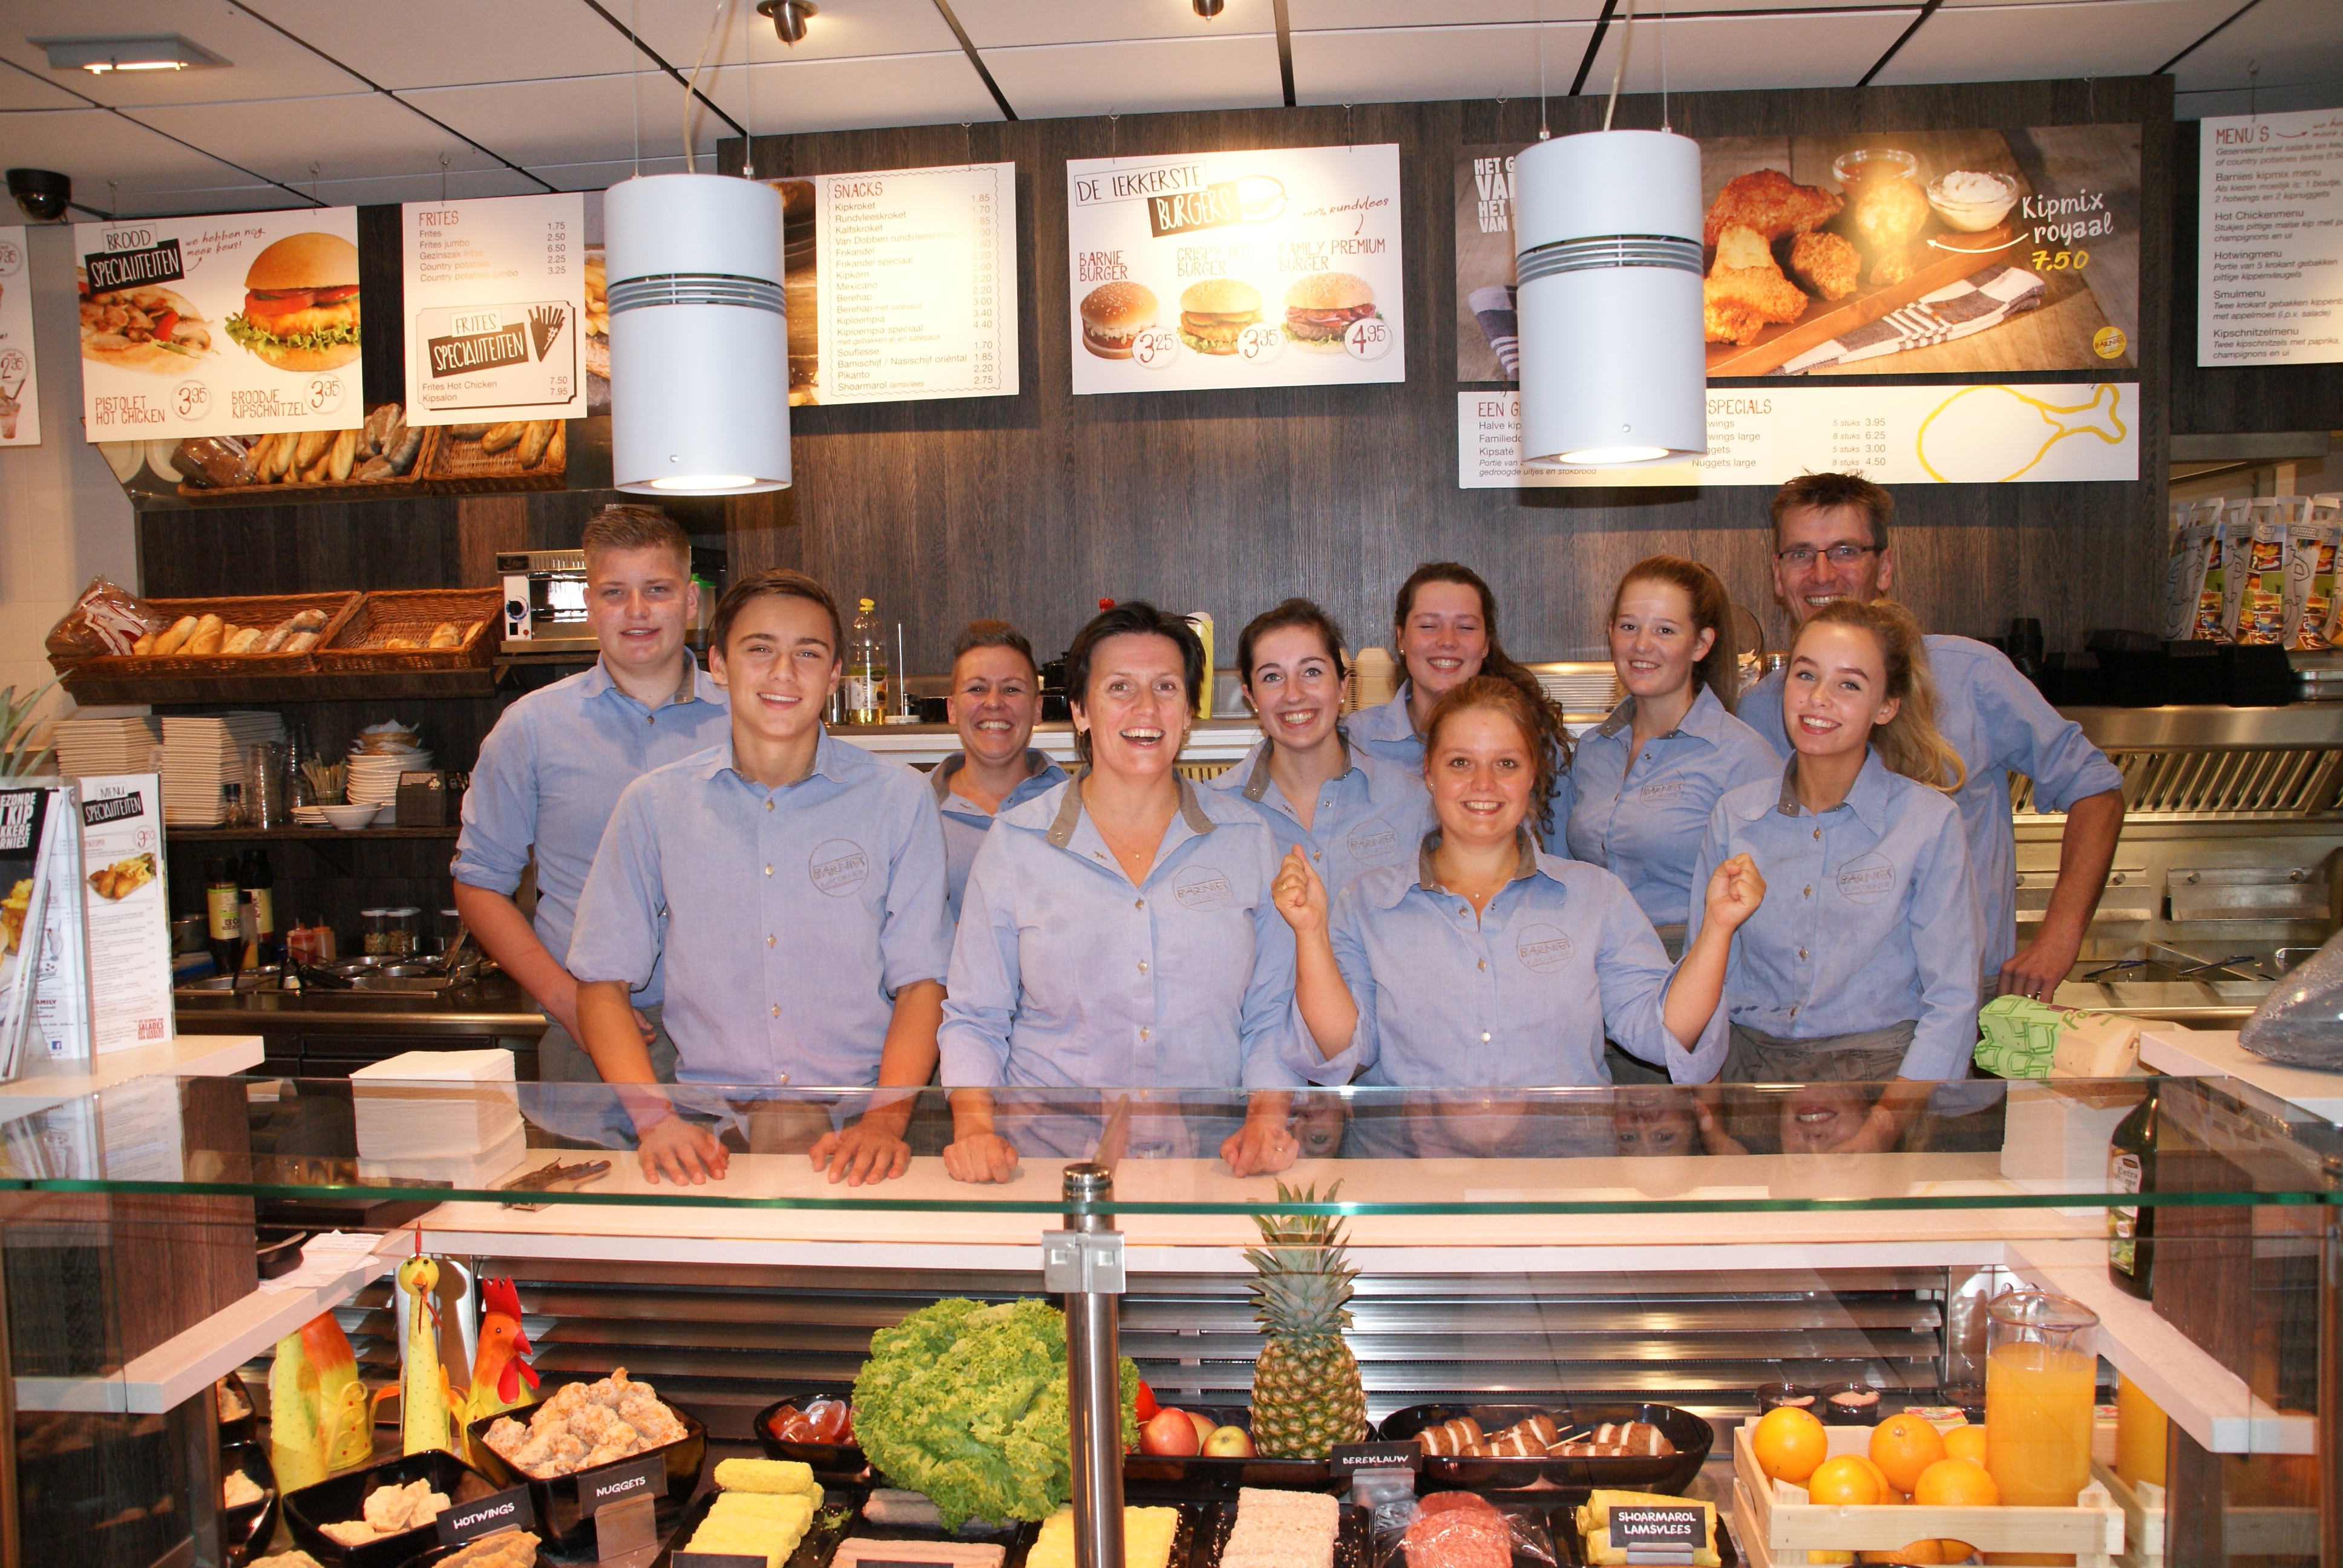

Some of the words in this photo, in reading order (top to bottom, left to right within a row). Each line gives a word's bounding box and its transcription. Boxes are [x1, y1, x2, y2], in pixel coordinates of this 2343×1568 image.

[1475, 158, 1500, 174] HET
[2216, 173, 2253, 181] Barnies
[2256, 171, 2289, 180] kipmix
[834, 181, 883, 198] SNACKS
[1077, 180, 1101, 201] DE
[971, 194, 990, 203] 1.85
[836, 202, 876, 212] Kipkroket
[1156, 188, 1231, 230] BURGERS
[1478, 200, 1506, 218] HET
[2022, 189, 2103, 222] Kipmix
[419, 211, 459, 226] FRITES
[836, 211, 906, 223] Rundvleeskroket
[2215, 212, 2232, 221] Hot
[2235, 210, 2304, 220] Chickenmenu
[548, 222, 565, 230] 1.75
[836, 224, 883, 234] Kalfskroket
[1479, 216, 1508, 233] VAN
[2034, 212, 2114, 246] royaal
[106, 230, 151, 250] BROOD
[203, 230, 240, 243] hebben
[547, 233, 566, 242] 2.50
[836, 237, 851, 246] Van
[854, 235, 888, 244] Dobben
[444, 240, 470, 249] jumbo
[548, 244, 566, 252] 6.50
[1279, 241, 1325, 256] FAMILY
[1332, 238, 1385, 255] PREMIUM
[420, 251, 461, 260] Gezinszak
[836, 247, 874, 256] Frikandel
[1177, 246, 1222, 262] CRISPY
[2215, 250, 2282, 261] Hotwingmenu
[548, 255, 566, 264] 2.25
[836, 259, 875, 268] Frikandel
[877, 256, 913, 266] speciaal
[1080, 250, 1124, 266] BARNIE
[2032, 250, 2089, 271] 7.50
[91, 249, 180, 287] SPECIALITEITEN
[420, 261, 452, 272] Country
[455, 260, 490, 270] potatoes
[1178, 261, 1226, 276] BURGER
[1280, 256, 1328, 272] BURGER
[2297, 259, 2338, 269] gebakken
[421, 273, 452, 283] Country
[836, 271, 869, 280] Kipkorn
[1080, 266, 1128, 281] BURGER
[2214, 273, 2239, 282] pittige
[2241, 271, 2302, 281] kippenvleugels
[836, 282, 877, 290] Mexicano
[837, 294, 873, 302] Berehap
[2214, 290, 2266, 299] Smulmenu
[973, 297, 992, 305] 3.00
[837, 305, 873, 314] Berehap
[456, 313, 496, 334] FRITES
[837, 316, 885, 325] Kiploempia
[837, 327, 885, 336] Kiploempia
[888, 324, 923, 334] speciaal
[2214, 328, 2299, 339] Kipschnitzelmenu
[434, 332, 524, 371] SPECIALITEITEN
[837, 348, 879, 357] Souflesse
[974, 353, 993, 361] 1.85
[838, 359, 882, 369] Bamischijf
[891, 356, 932, 366] Nasischijf
[974, 364, 993, 373] 2.20
[838, 371, 870, 379] Pikanto
[974, 376, 993, 384] 2.75
[422, 383, 445, 391] Frites
[464, 381, 497, 389] Chicken
[838, 382, 887, 391] Shoarmarol
[232, 389, 280, 405] BROODJE
[423, 394, 457, 403] Kipsalon
[96, 396, 146, 411] PISTOLET
[1705, 399, 1772, 414] SPECIALS
[232, 402, 307, 419] KIPSCHNITZEL
[1478, 402, 1504, 417] EEN
[96, 411, 115, 425] HOT
[121, 409, 165, 423] CHICKEN
[1866, 418, 1886, 426] 3.95
[1480, 422, 1504, 430] Halve
[1738, 433, 1760, 441] large
[1480, 448, 1513, 457] Kipsaté
[1692, 460, 1731, 468] Nuggets
[1734, 459, 1756, 467] large
[1866, 457, 1886, 466] 4.50
[100, 786, 125, 799] MENU
[0, 792, 36, 807] EZONDE
[7, 805, 34, 826] KIP
[85, 797, 141, 823] SPECIALITEITEN
[0, 823, 31, 838] KKERE
[0, 837, 30, 849] RNIES!
[2119, 1166, 2137, 1179] Extra
[1342, 1454, 1409, 1465] BEREKLAUW
[596, 1475, 646, 1498] NUGGETS
[453, 1502, 515, 1530] HOTWINGS
[1619, 1512, 1696, 1523] SHOARMAROL
[1624, 1524, 1691, 1535] LAMSVLEES
